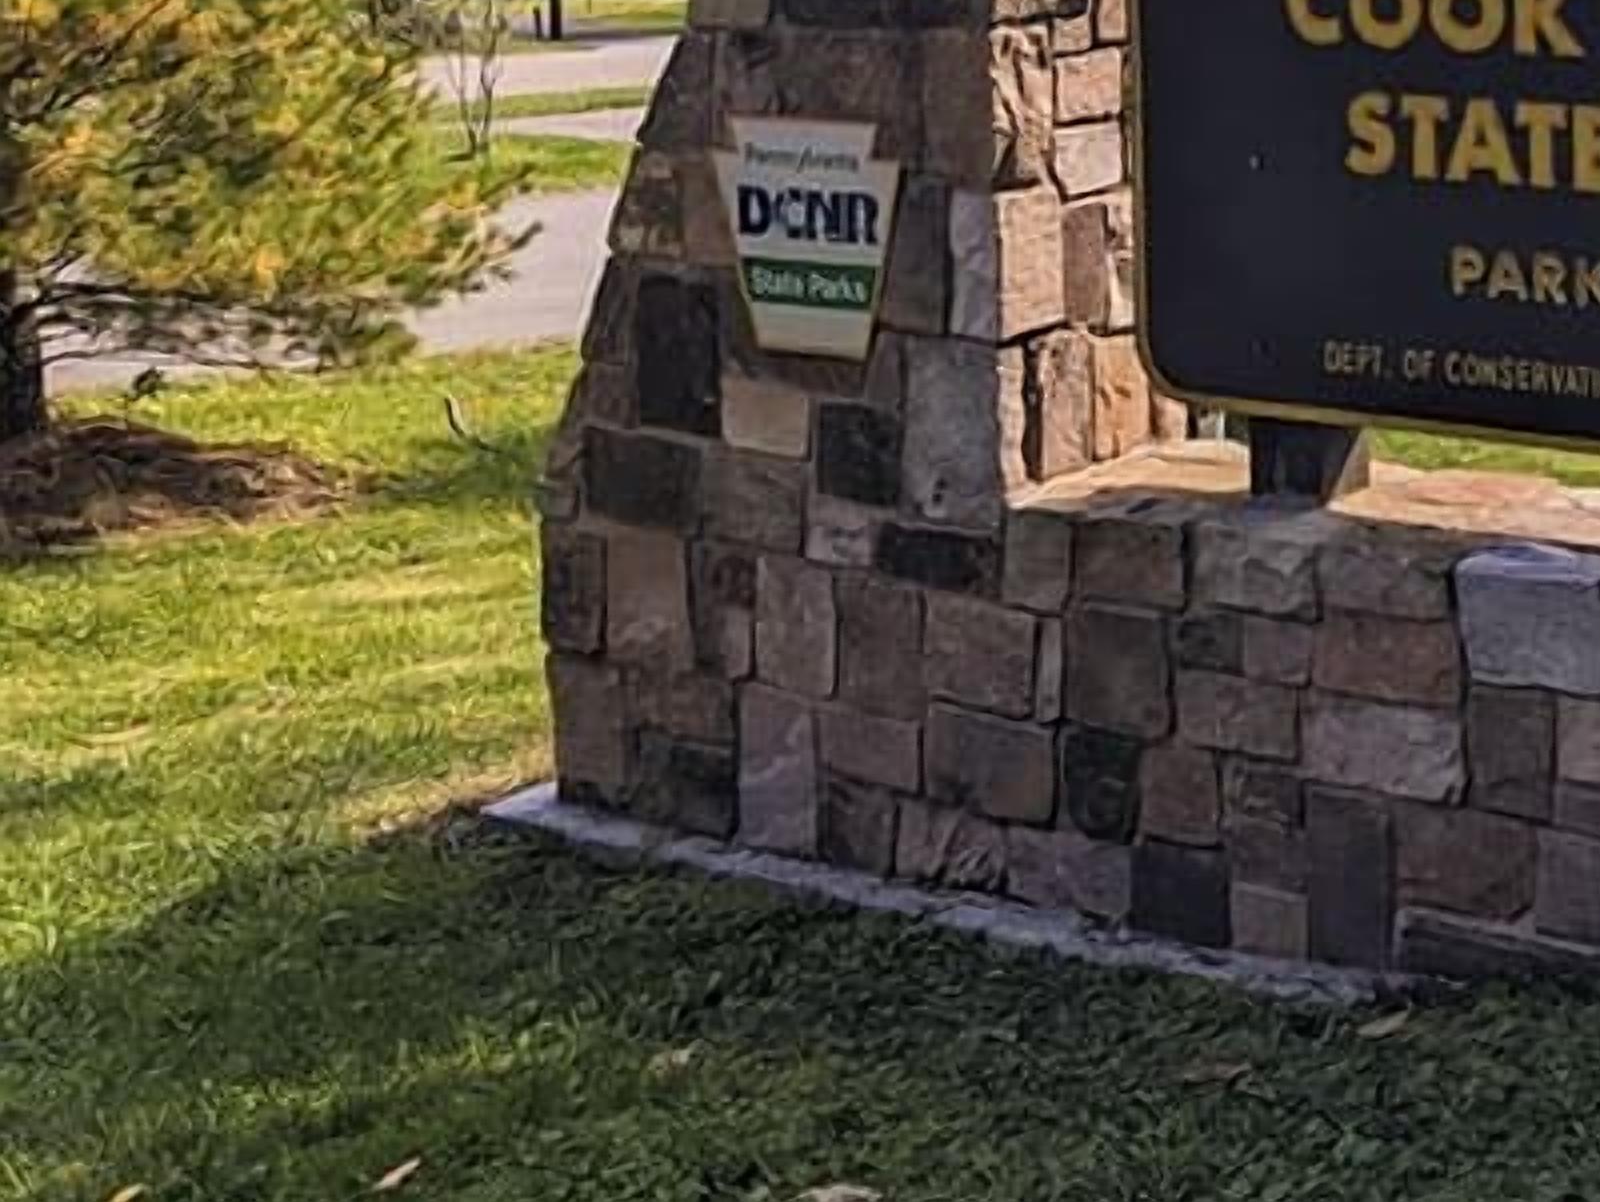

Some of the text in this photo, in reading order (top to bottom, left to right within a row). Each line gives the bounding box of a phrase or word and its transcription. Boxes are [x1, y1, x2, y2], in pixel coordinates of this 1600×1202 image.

[738, 185, 879, 244] DCNR
[1323, 341, 1391, 378] DEPT.
[1403, 349, 1434, 379] OF
